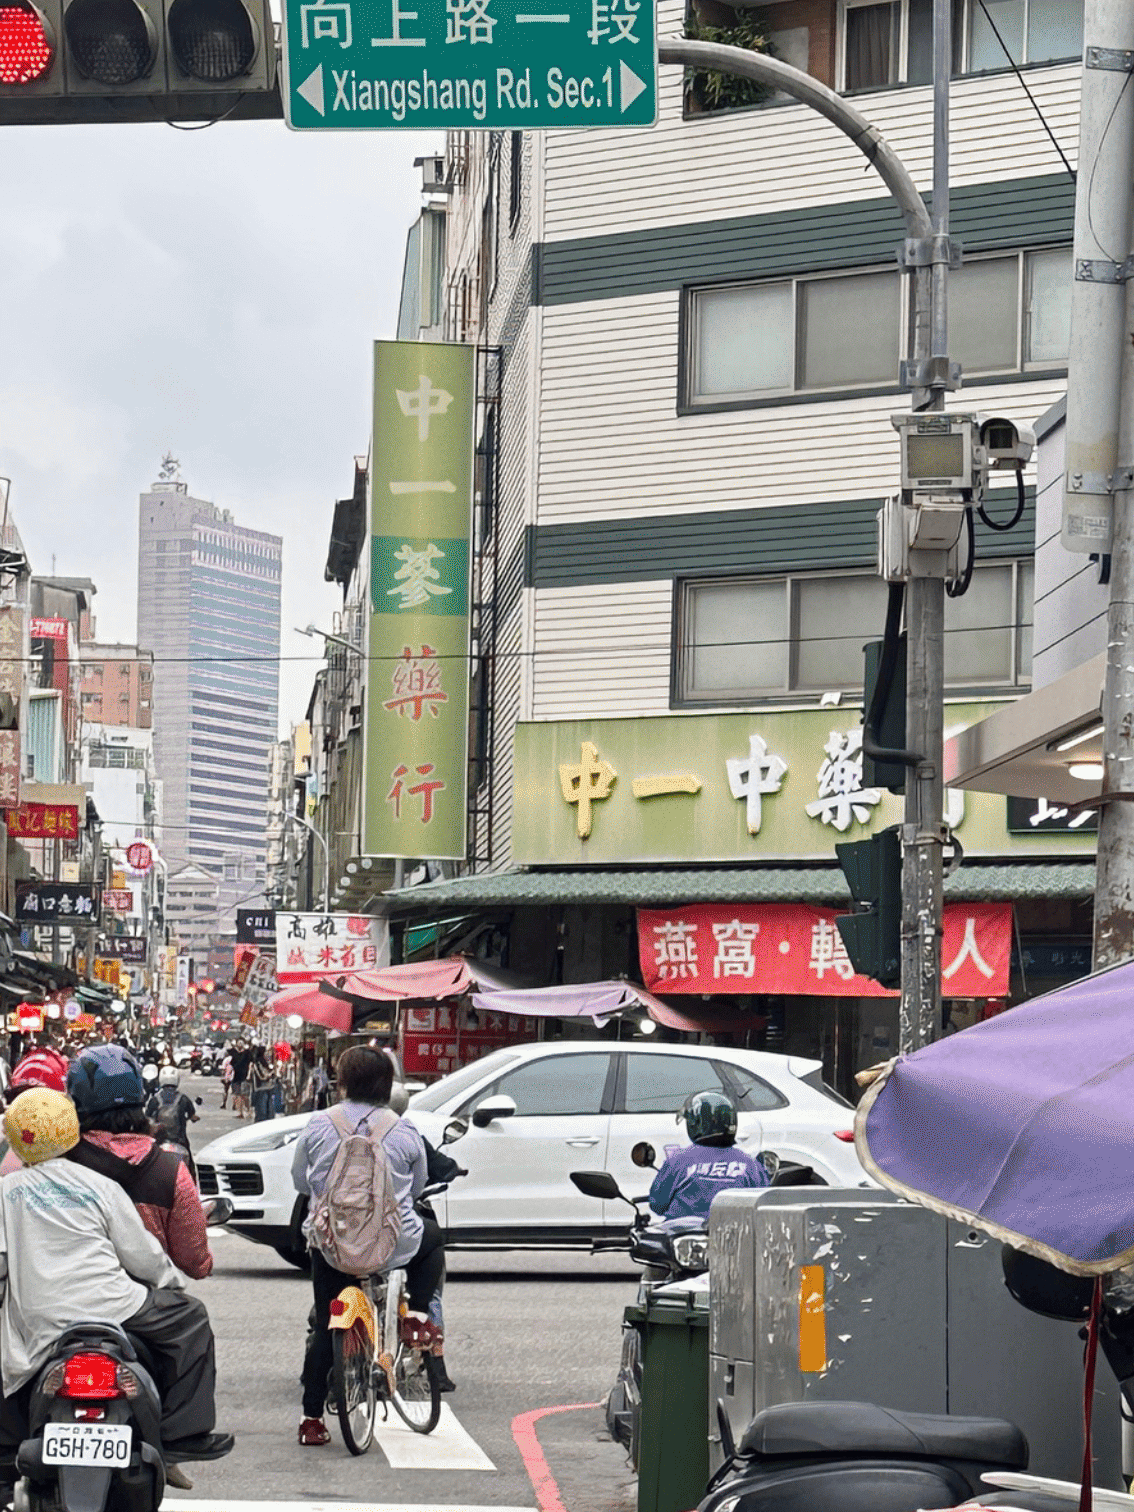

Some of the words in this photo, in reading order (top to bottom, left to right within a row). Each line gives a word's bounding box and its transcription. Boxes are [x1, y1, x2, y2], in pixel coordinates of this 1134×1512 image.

[300, 0, 641, 47] 向上路一段
[331, 68, 487, 120] Xiangshang
[497, 68, 540, 109] Rd.
[546, 65, 614, 108] Sec.1
[558, 729, 964, 841] 中一中藥
[653, 917, 994, 981] 燕窩·轉人
